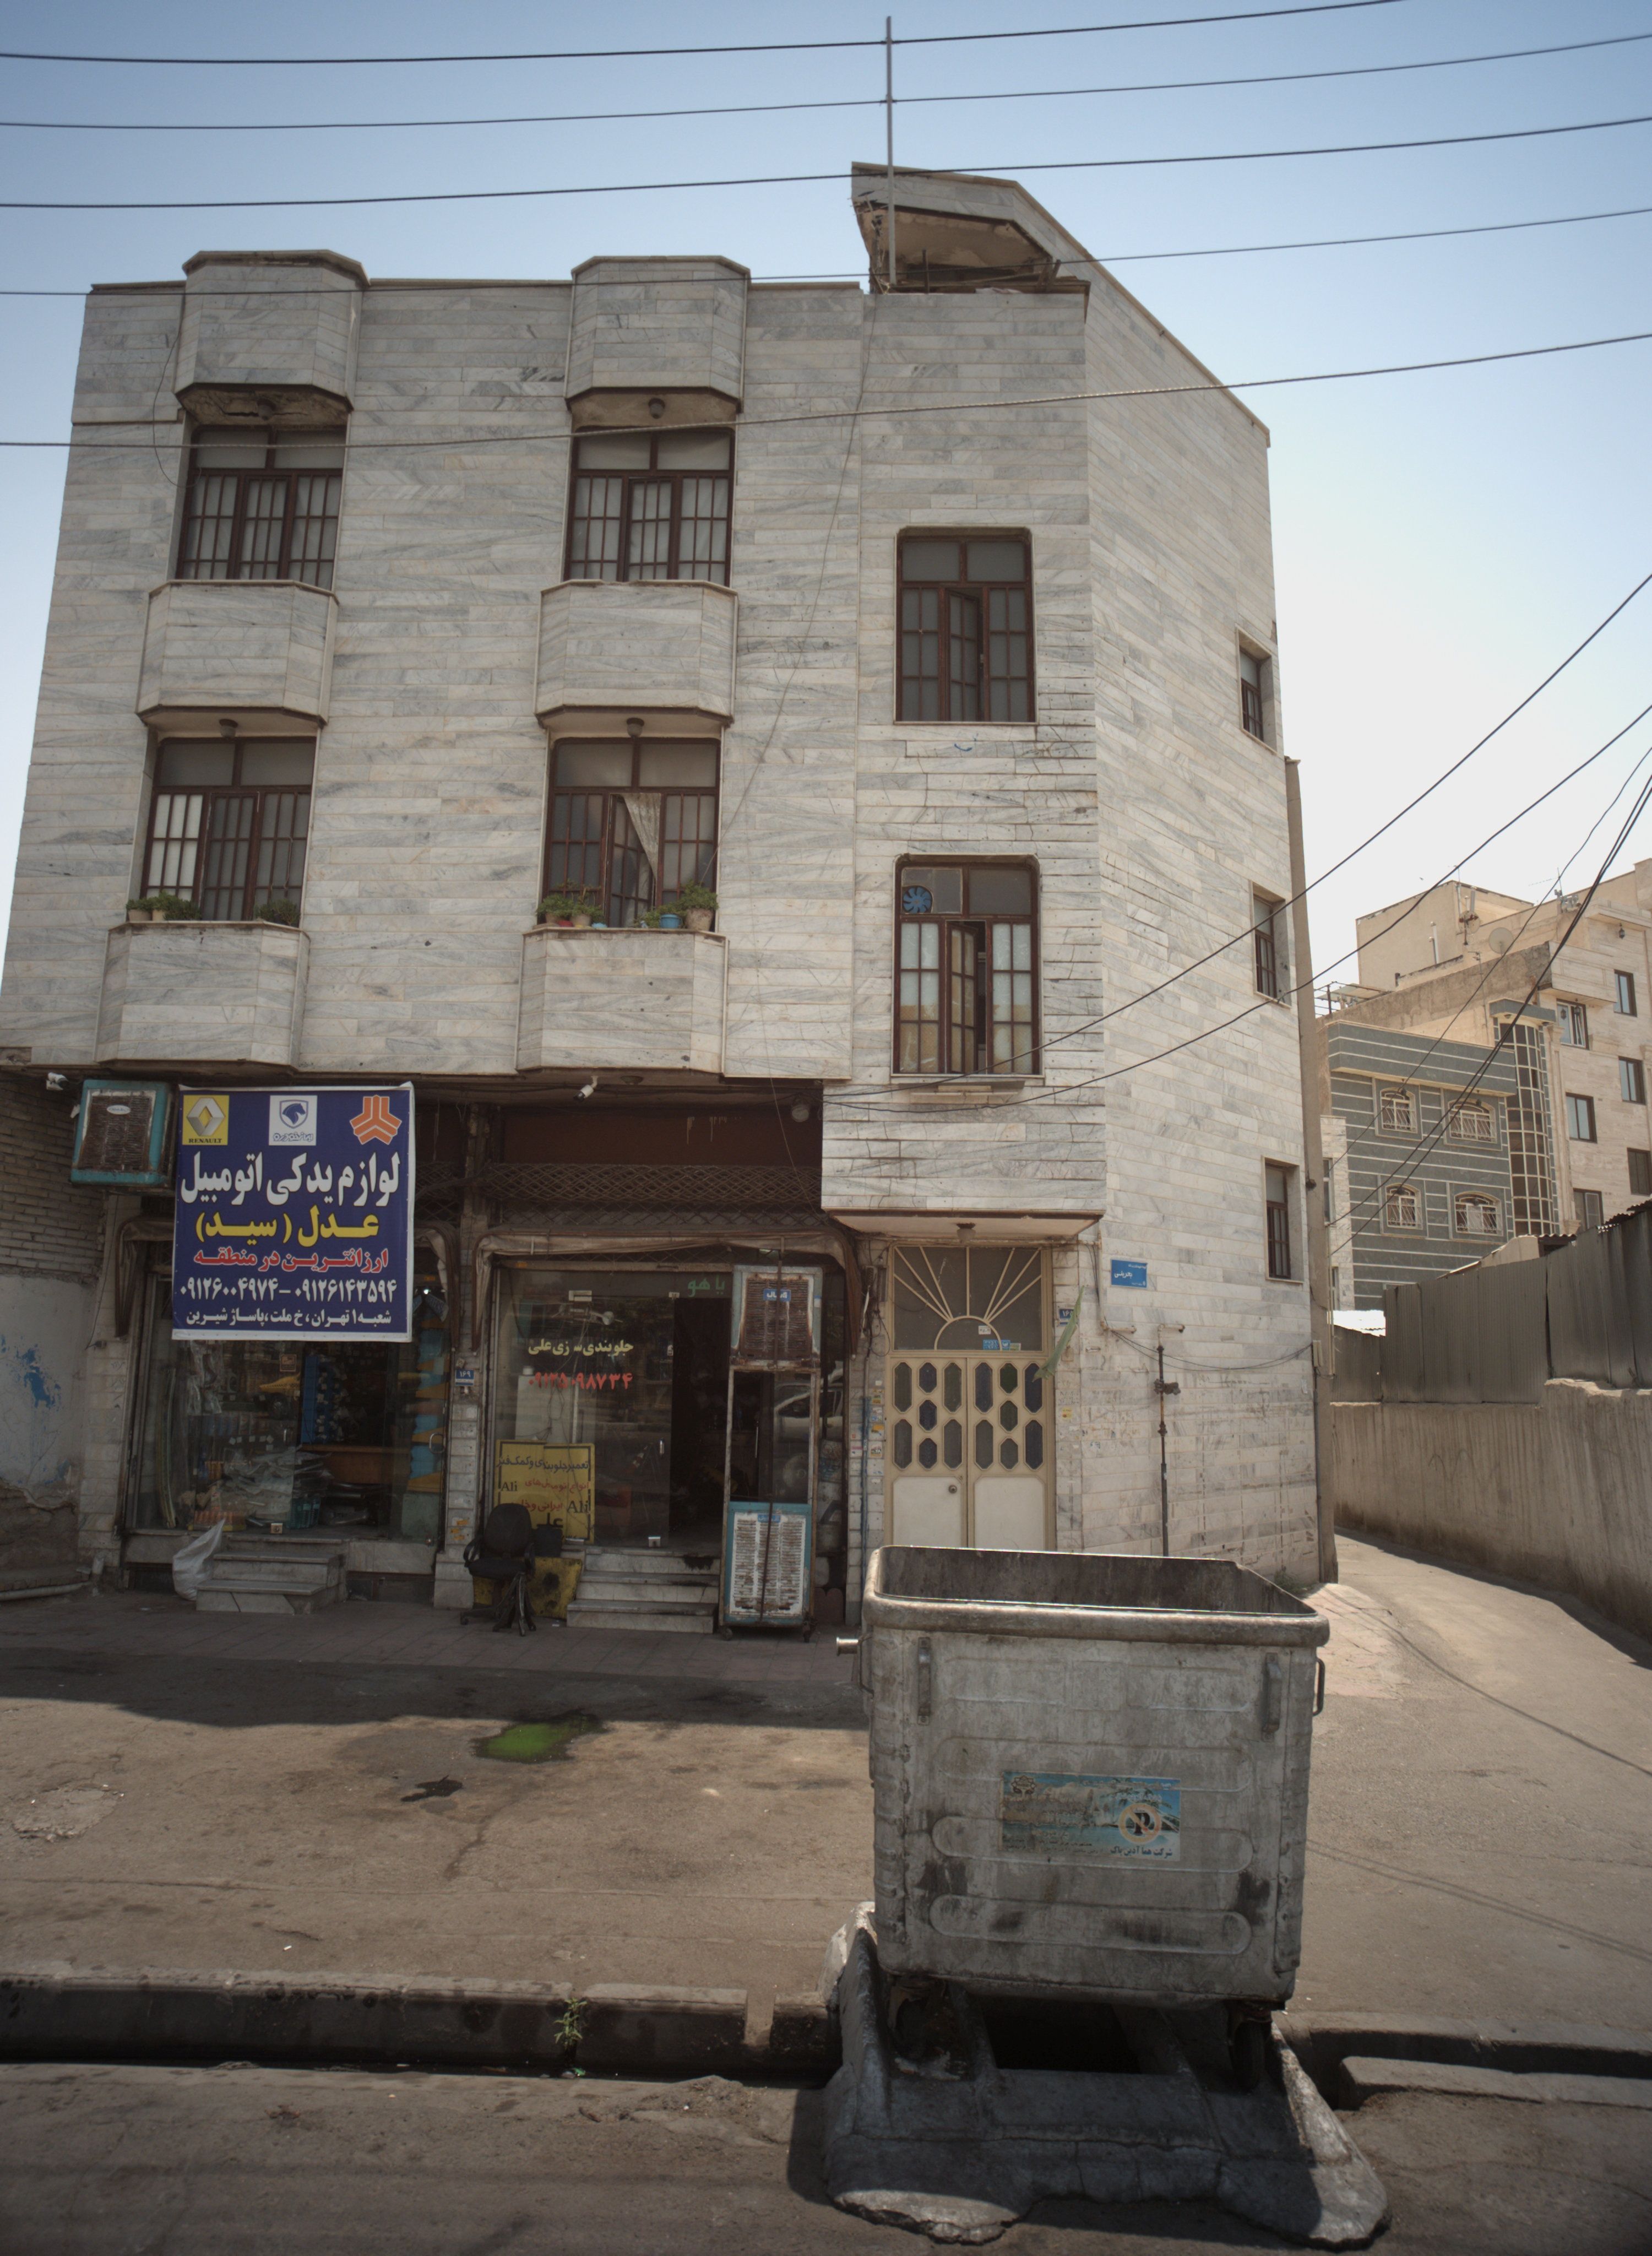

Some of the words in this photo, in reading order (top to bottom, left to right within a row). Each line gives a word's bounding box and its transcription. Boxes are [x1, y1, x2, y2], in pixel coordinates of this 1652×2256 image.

[181, 1151, 263, 1206] اتومبیل
[267, 1153, 334, 1205] یدکی
[339, 1152, 401, 1207] لوازم
[298, 1205, 379, 1248] عدل
[193, 1246, 257, 1266] منطقه
[258, 1251, 280, 1272] در
[281, 1248, 389, 1274] ارزانترین
[180, 1277, 279, 1301] ۰۹۱۲۶۰۰۴۹۷۴
[295, 1278, 397, 1303] ۰۹۱۲۶۱۴۳۵۹۴
[687, 1277, 711, 1298] هو
[715, 1274, 726, 1295] یا
[186, 1307, 228, 1326] شیرین
[294, 1309, 303, 1326] خ
[358, 1310, 392, 1327] شعبه
[528, 1338, 552, 1355] علی
[552, 1340, 583, 1356] سزی
[583, 1340, 634, 1356] جلوبندی
[501, 1481, 518, 1492] Ali
[567, 1500, 590, 1514] Ali
